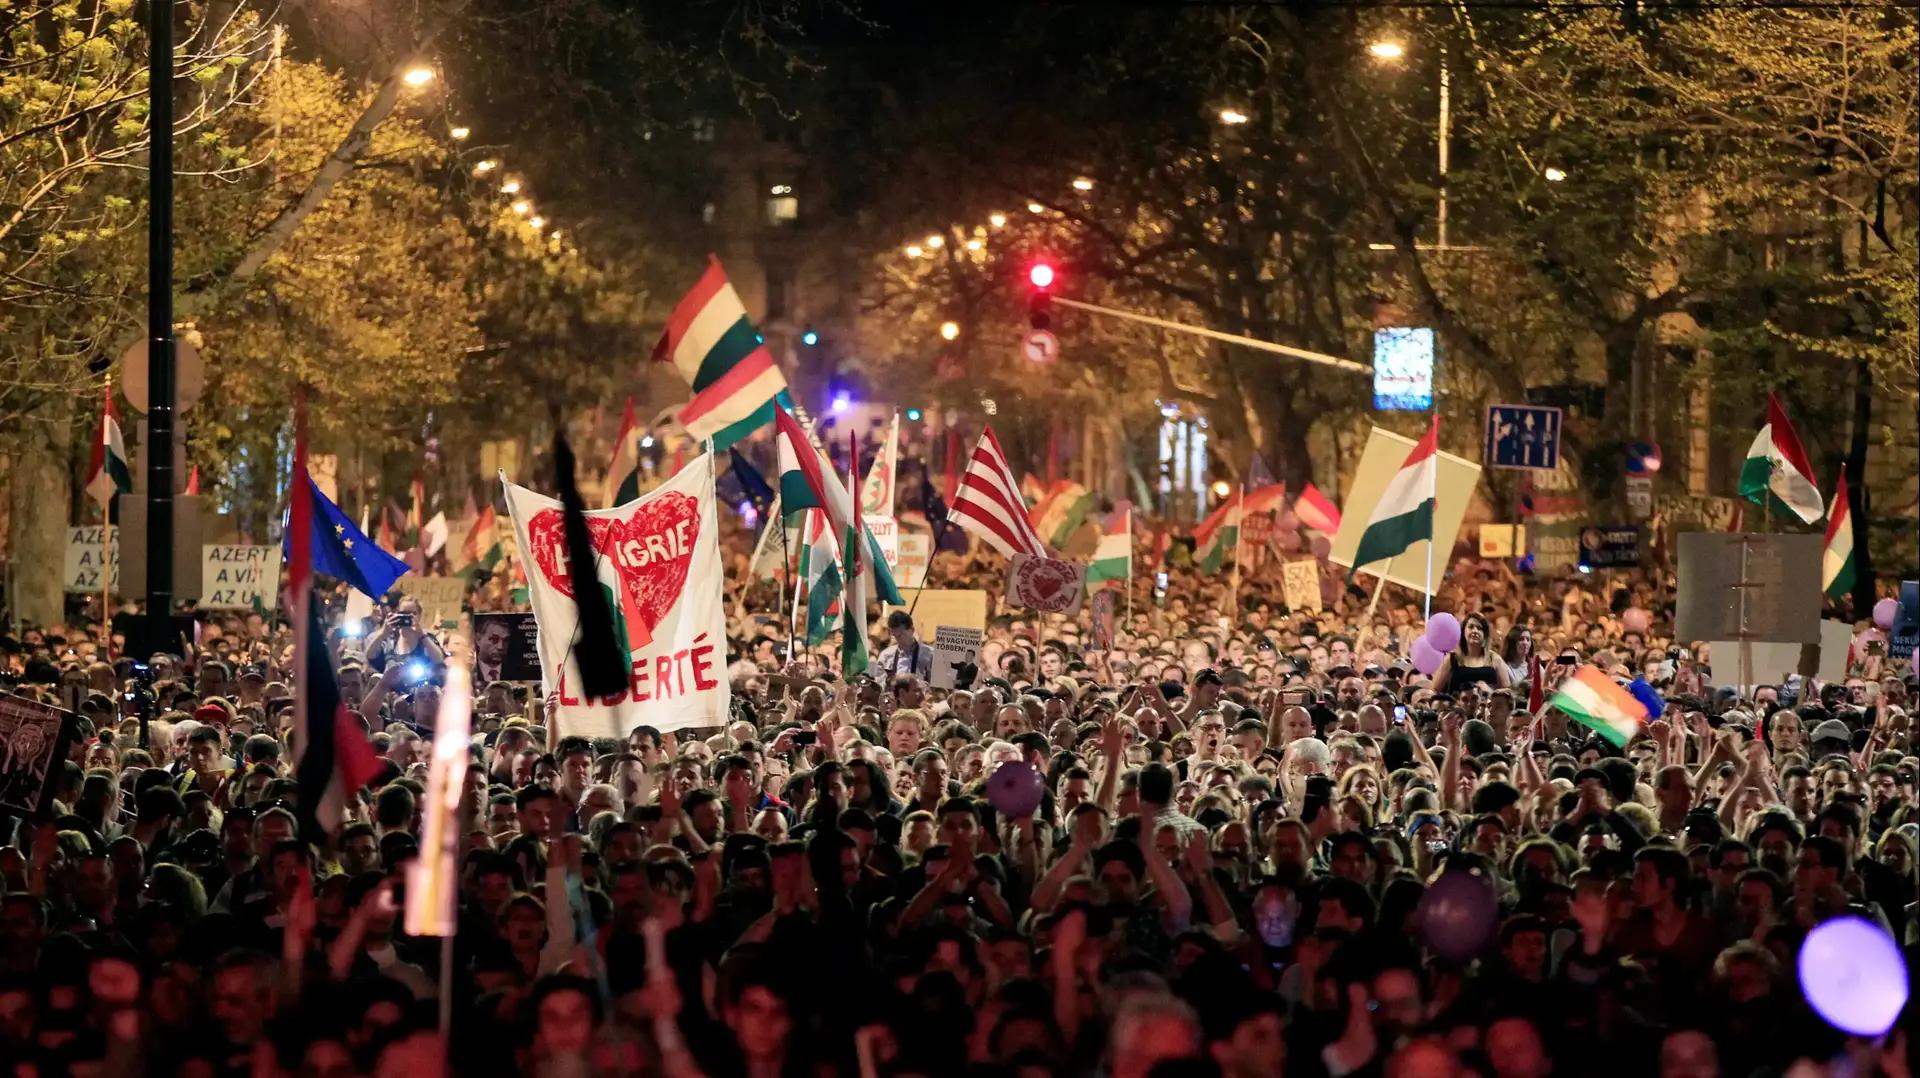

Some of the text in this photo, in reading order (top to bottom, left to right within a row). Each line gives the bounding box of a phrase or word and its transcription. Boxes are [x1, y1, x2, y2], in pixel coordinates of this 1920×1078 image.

[79, 551, 92, 566] A
[74, 571, 99, 586] AZ
[215, 569, 228, 583] A
[210, 590, 236, 605] AZ
[946, 636, 980, 646] VAGYUNK
[557, 632, 718, 709] LERTÉ
